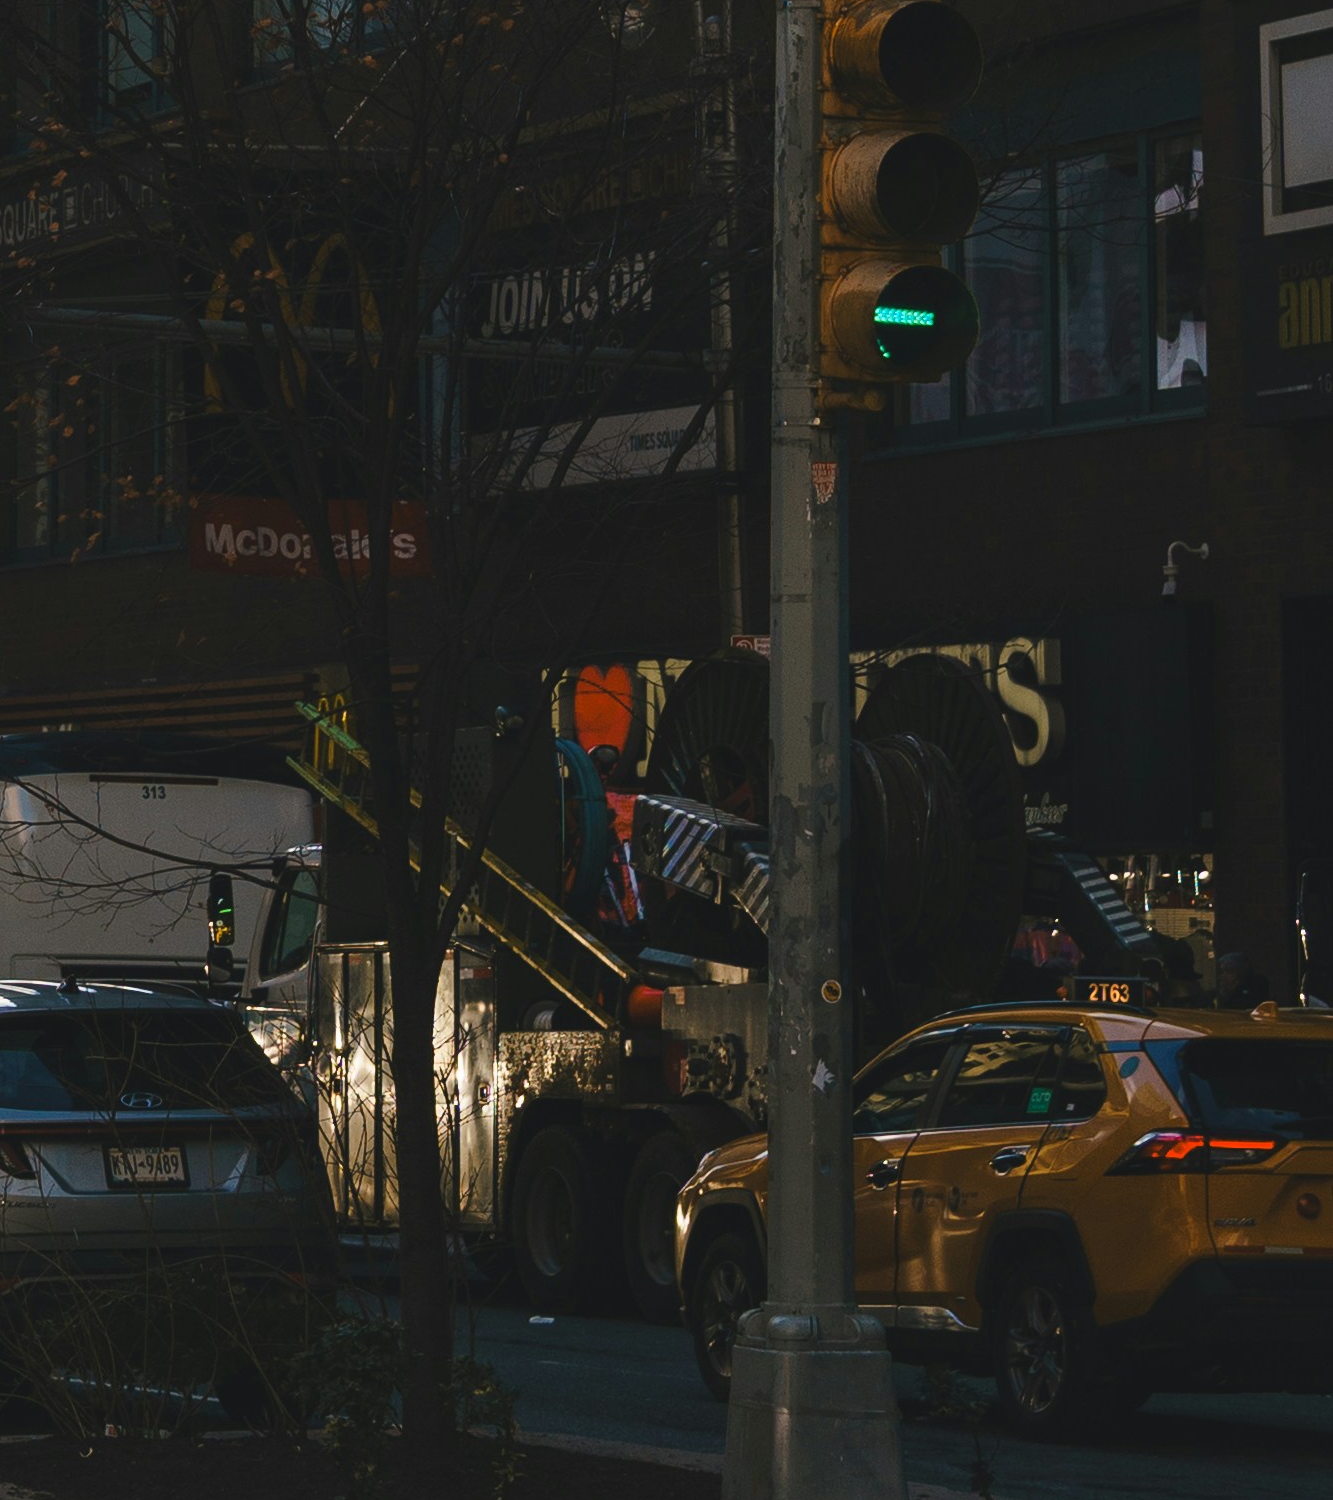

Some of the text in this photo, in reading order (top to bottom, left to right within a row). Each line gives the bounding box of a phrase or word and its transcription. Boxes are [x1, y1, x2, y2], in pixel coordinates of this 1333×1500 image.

[480, 270, 551, 339] JOIN
[205, 522, 418, 560] McDoals
[141, 784, 167, 800] 313
[1088, 983, 1130, 1003] 2T63
